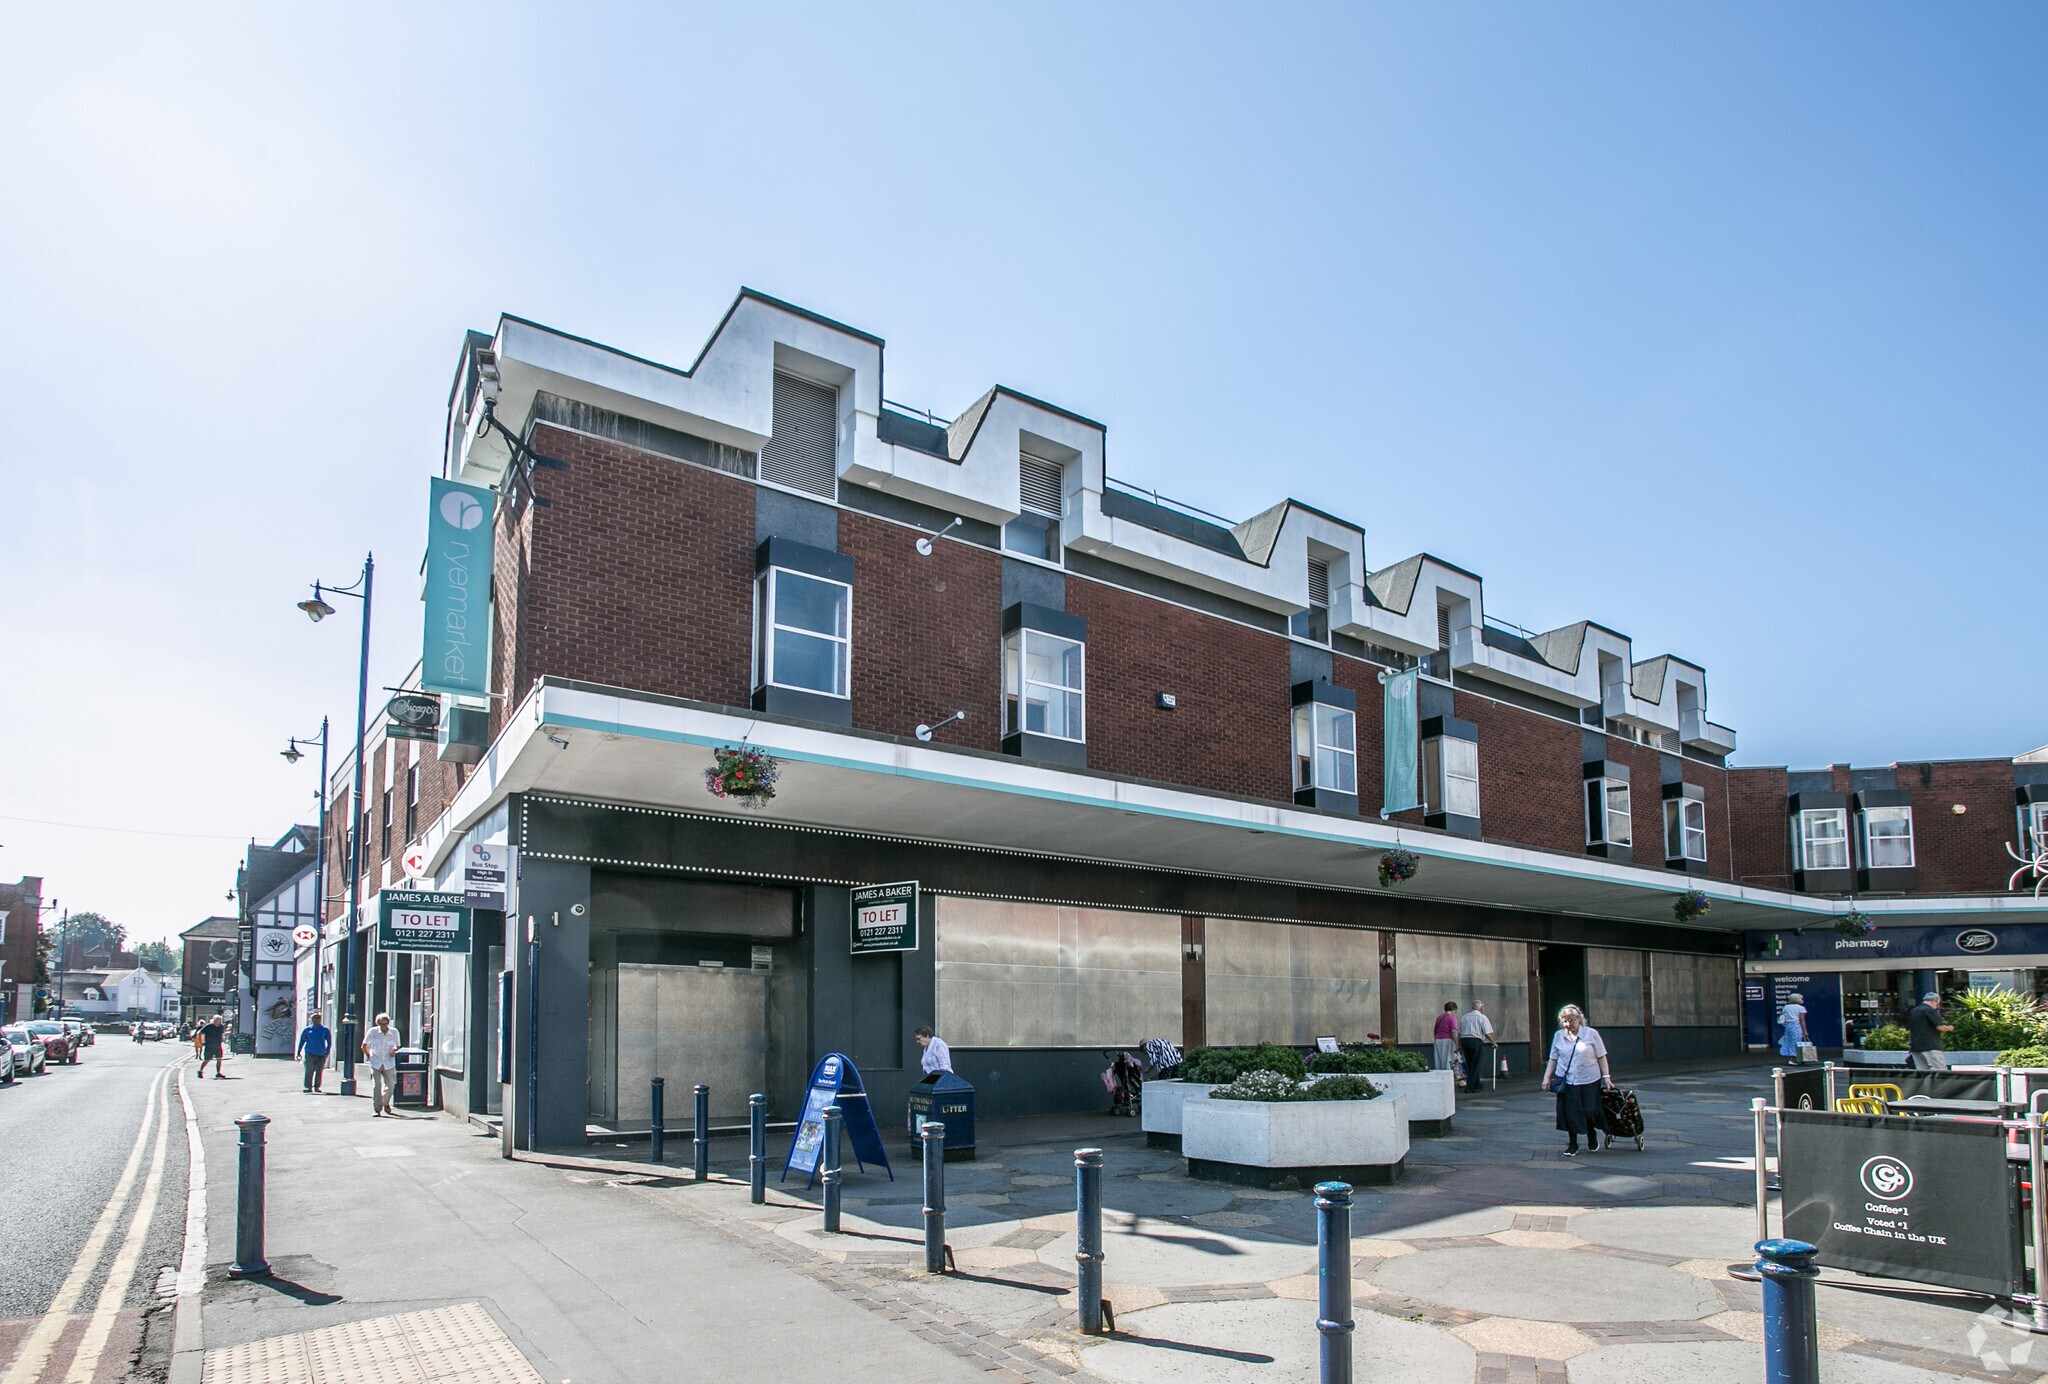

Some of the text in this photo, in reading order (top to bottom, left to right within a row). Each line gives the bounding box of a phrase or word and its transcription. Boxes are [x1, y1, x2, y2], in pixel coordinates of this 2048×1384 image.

[444, 541, 472, 684] ryemarket
[394, 699, 439, 720] Chicago's
[484, 862, 499, 870] Stop
[386, 892, 465, 904] JAMES A BAKER
[854, 886, 912, 900] JAMES A BAKER
[401, 914, 451, 926] TO LET
[862, 909, 899, 924] TO LET
[395, 929, 455, 939] 0121 227 2311
[860, 926, 903, 937] 0121 227 2311
[1835, 939, 1890, 949] pharmacy
[1961, 934, 1992, 947] Boots
[1774, 975, 1810, 983] welcome
[1866, 1217, 1896, 1228] Voted
[1833, 1222, 1947, 1245] Coffee Chain in the UK
